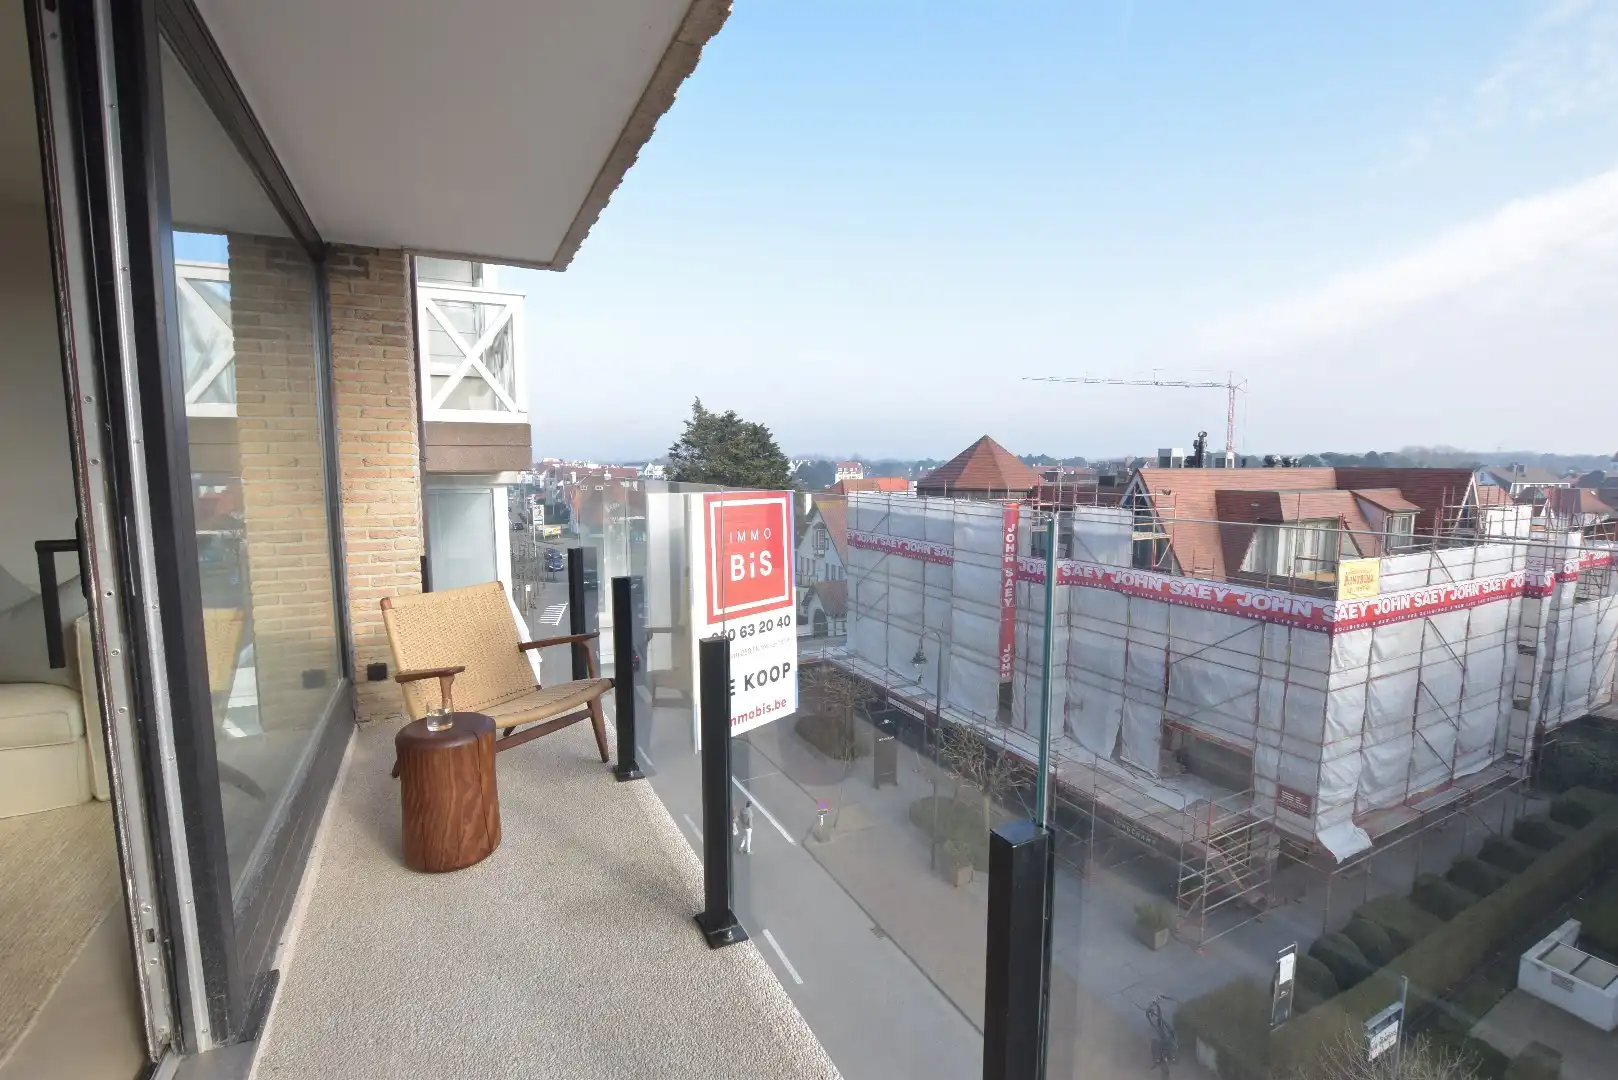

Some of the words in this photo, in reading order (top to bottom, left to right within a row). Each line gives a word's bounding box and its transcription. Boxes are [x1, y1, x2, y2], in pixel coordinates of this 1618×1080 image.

[729, 528, 772, 544] IMMO
[904, 541, 931, 555] JOHN
[1004, 523, 1016, 562] JOHN
[1004, 569, 1014, 607] SAEY
[1062, 563, 1106, 580] SAEY
[1111, 570, 1163, 593] JOHN
[1168, 580, 1231, 602] SAEY
[1236, 591, 1313, 618] JOHN
[1322, 599, 1369, 622] SAEY
[1373, 592, 1410, 616] JOHN
[1413, 587, 1448, 608] SAEY
[1450, 581, 1480, 601] JOHN
[1482, 577, 1508, 594] SAEY
[739, 623, 756, 639] 63
[758, 618, 774, 634] 20
[776, 614, 791, 629] 40
[1306, 623, 1328, 632] FOR
[743, 661, 791, 692] KOOP
